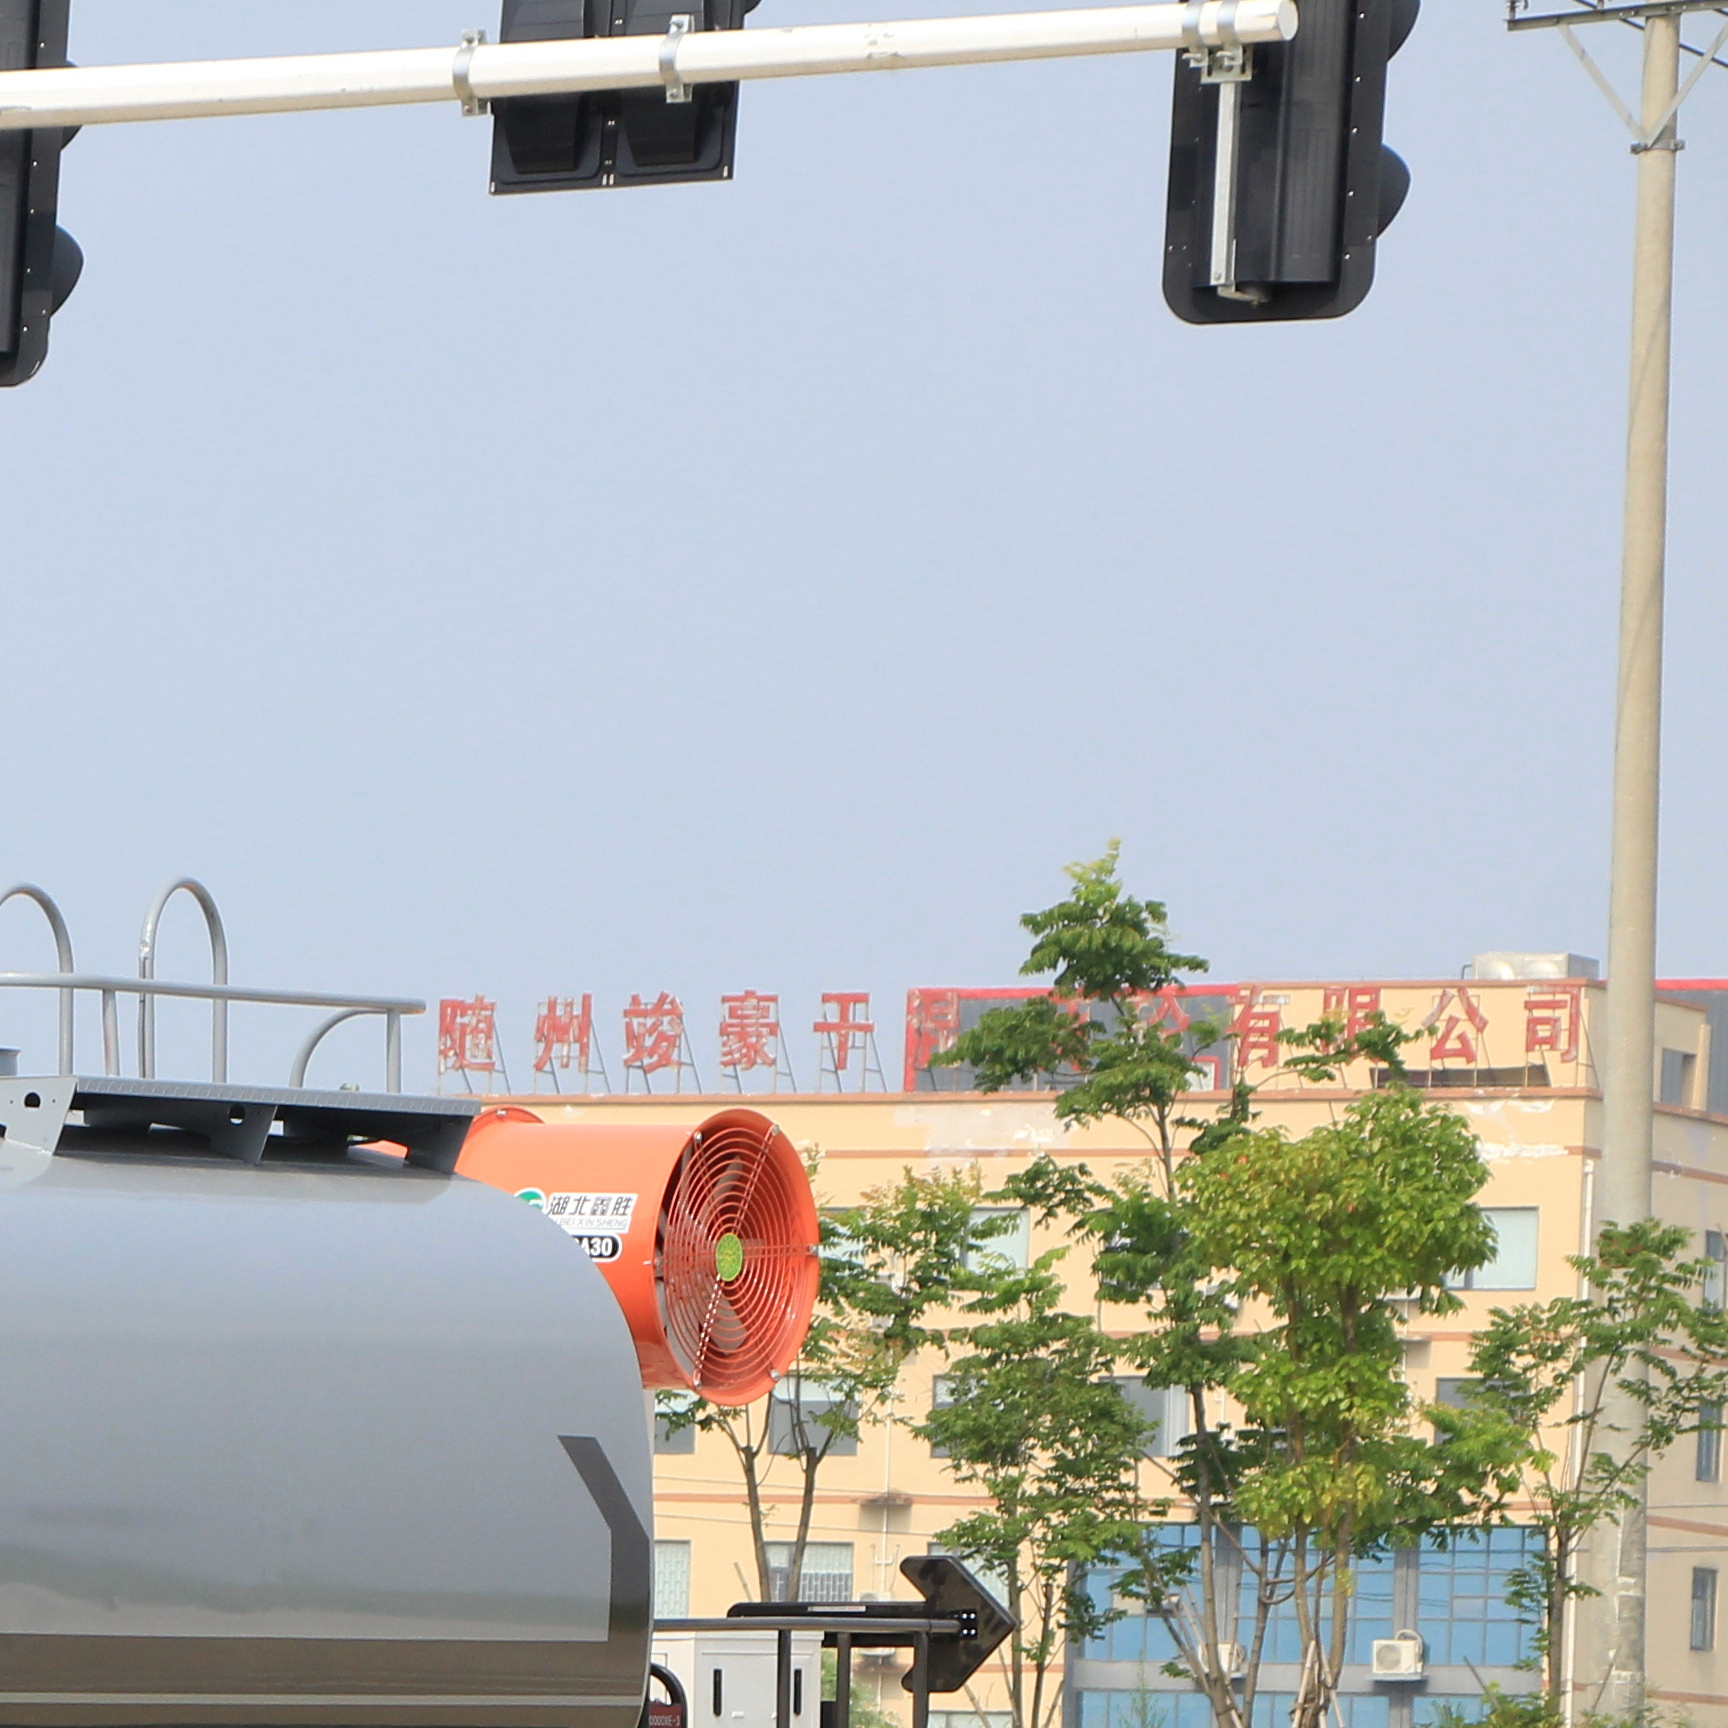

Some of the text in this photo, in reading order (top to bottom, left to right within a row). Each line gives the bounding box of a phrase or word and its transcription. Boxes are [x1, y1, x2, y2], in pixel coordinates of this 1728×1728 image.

[438, 986, 1580, 1074] 随州竣豪干混有限公司
